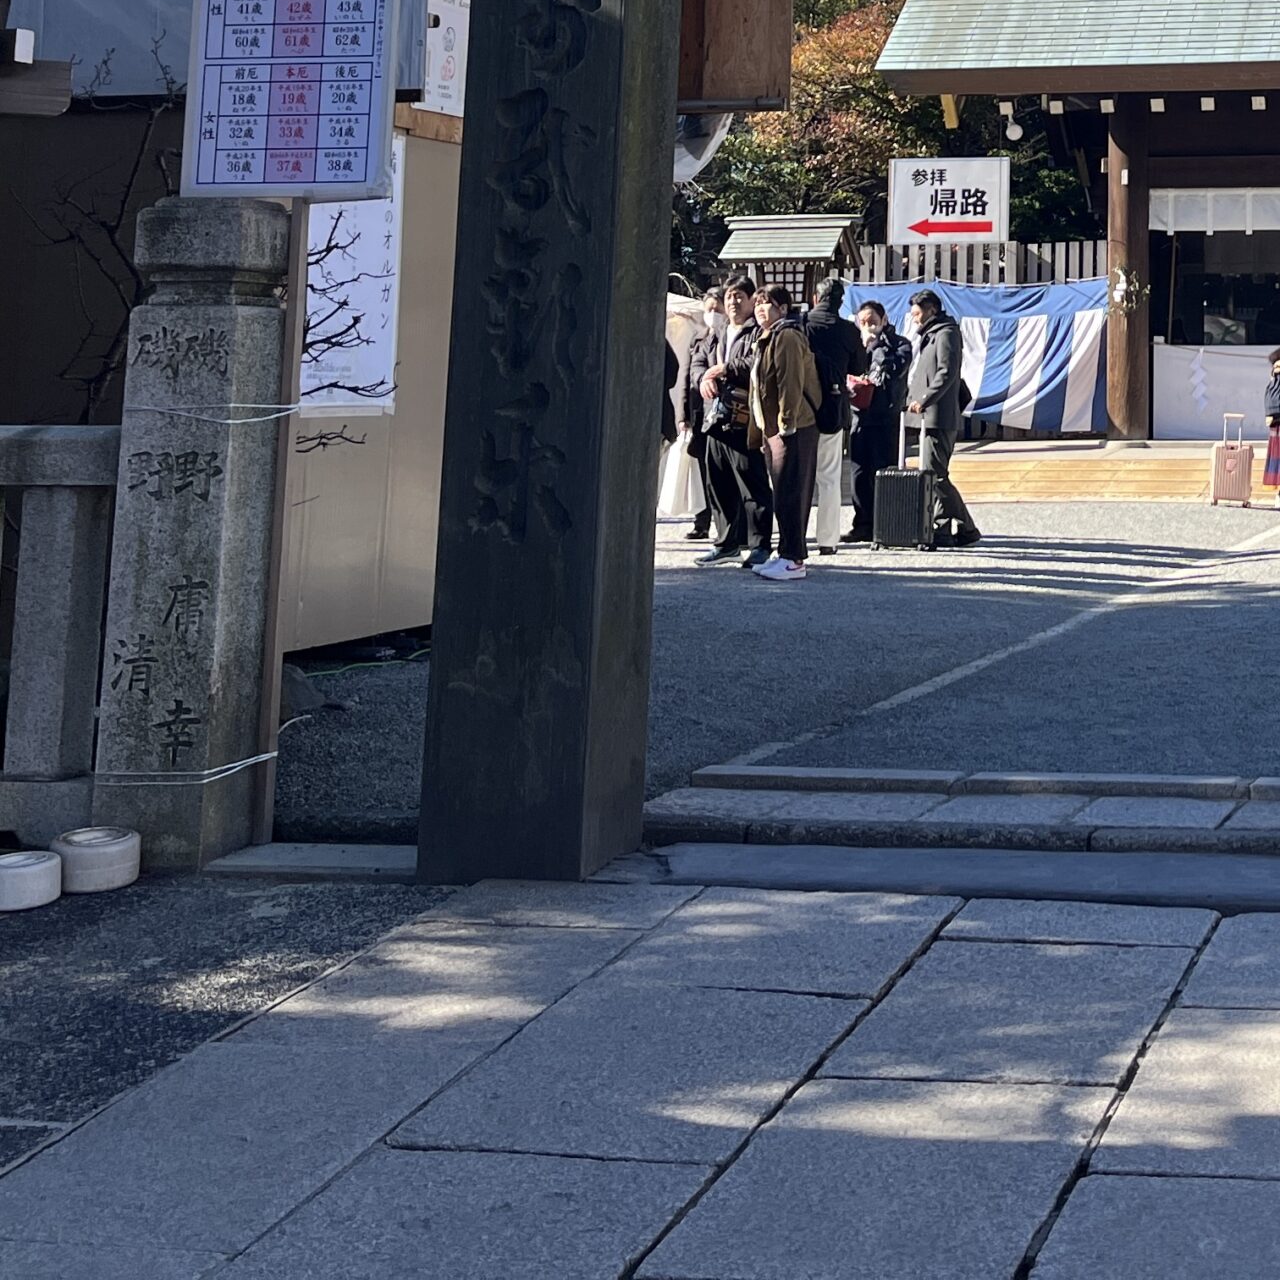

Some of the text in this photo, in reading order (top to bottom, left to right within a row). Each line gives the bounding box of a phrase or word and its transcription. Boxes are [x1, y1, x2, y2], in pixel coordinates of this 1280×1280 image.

[237, 2, 263, 15] 41歳
[286, 2, 312, 14] 42歳
[336, 0, 363, 13] 43歳
[235, 36, 261, 49] 60歳
[284, 35, 311, 48] 61歳
[335, 34, 361, 47] 62歳
[234, 67, 259, 80] 前厄
[285, 67, 309, 79] 本厄
[335, 66, 360, 78] 後厄
[232, 93, 257, 106] 18歳
[281, 93, 307, 105] 19歳
[331, 92, 358, 104] 20歳
[202, 112, 216, 140] 女性
[329, 126, 356, 138] 34歳
[229, 127, 255, 140] 32歳
[279, 127, 305, 139] 33歳
[226, 161, 253, 173] 36歳
[276, 160, 303, 172] 37歳
[327, 159, 353, 172] 38歳
[911, 168, 947, 186] 参拝
[930, 188, 988, 216] 帰路
